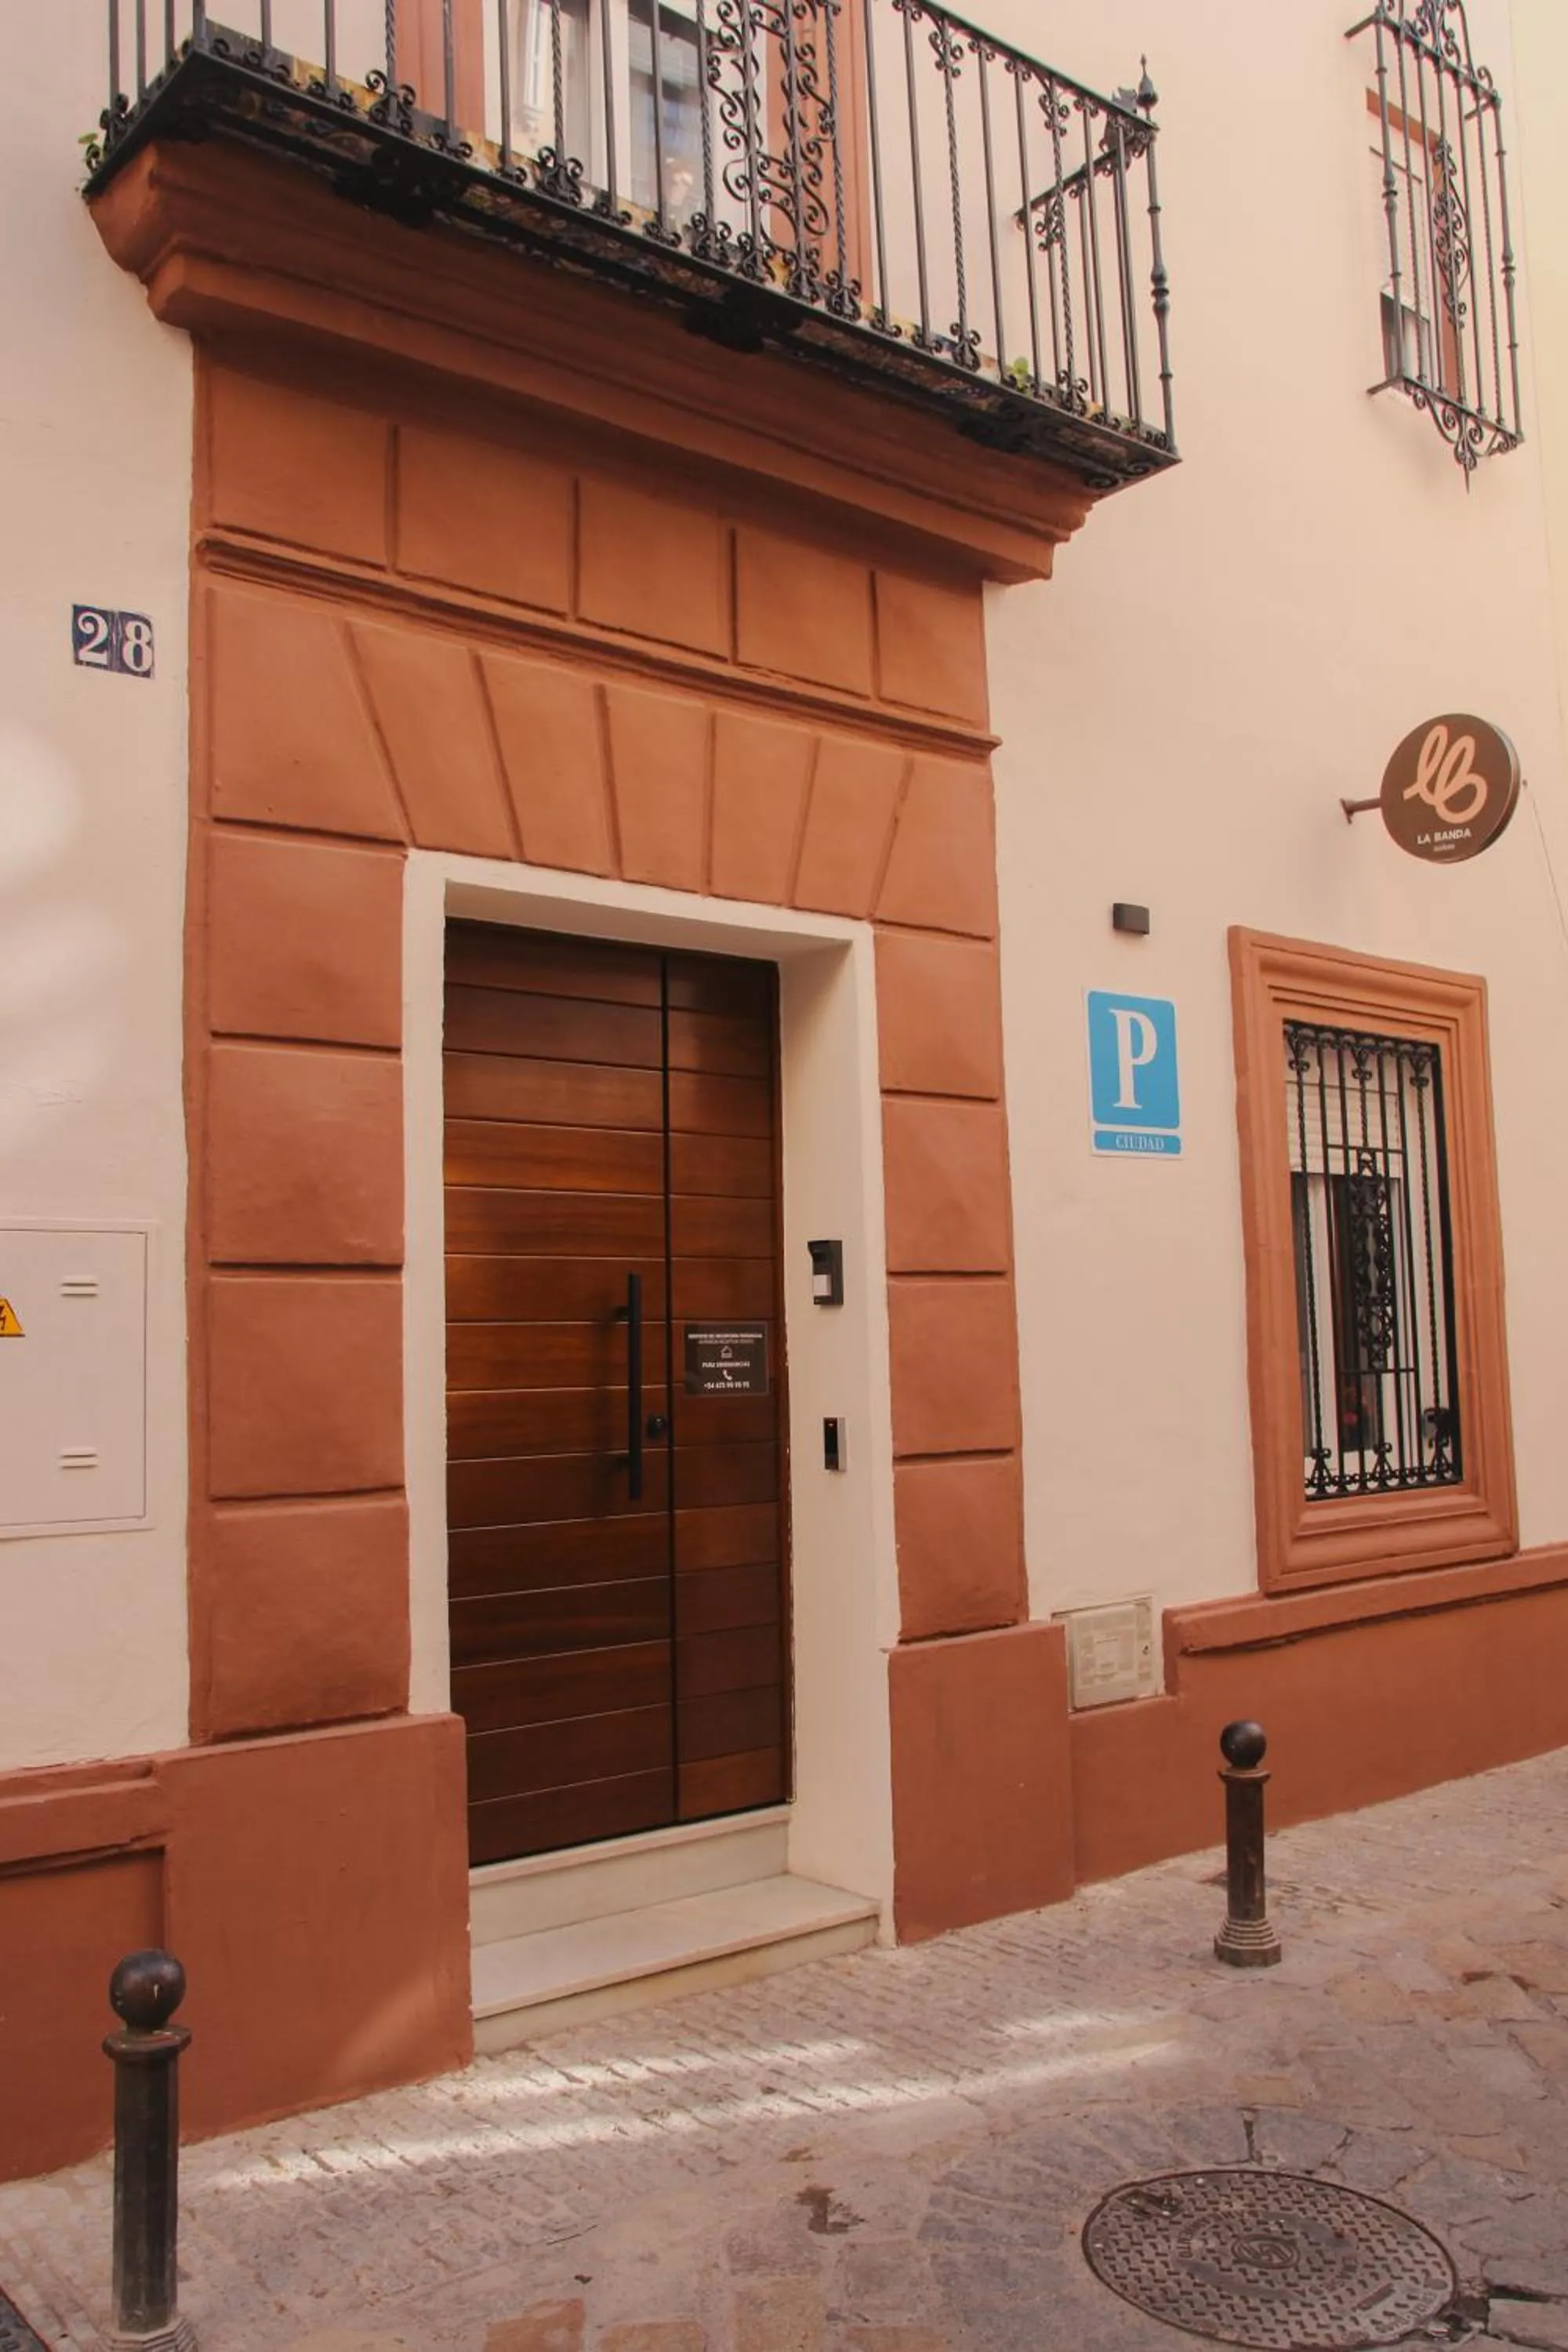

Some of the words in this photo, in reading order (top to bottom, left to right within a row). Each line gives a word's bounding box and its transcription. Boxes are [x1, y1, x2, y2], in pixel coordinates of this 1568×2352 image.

[78, 612, 153, 673] 28
[1417, 833, 1431, 845] LA
[1434, 828, 1472, 843] BANDA
[1108, 1008, 1158, 1109] P
[1116, 1134, 1164, 1151] CIUDAD
